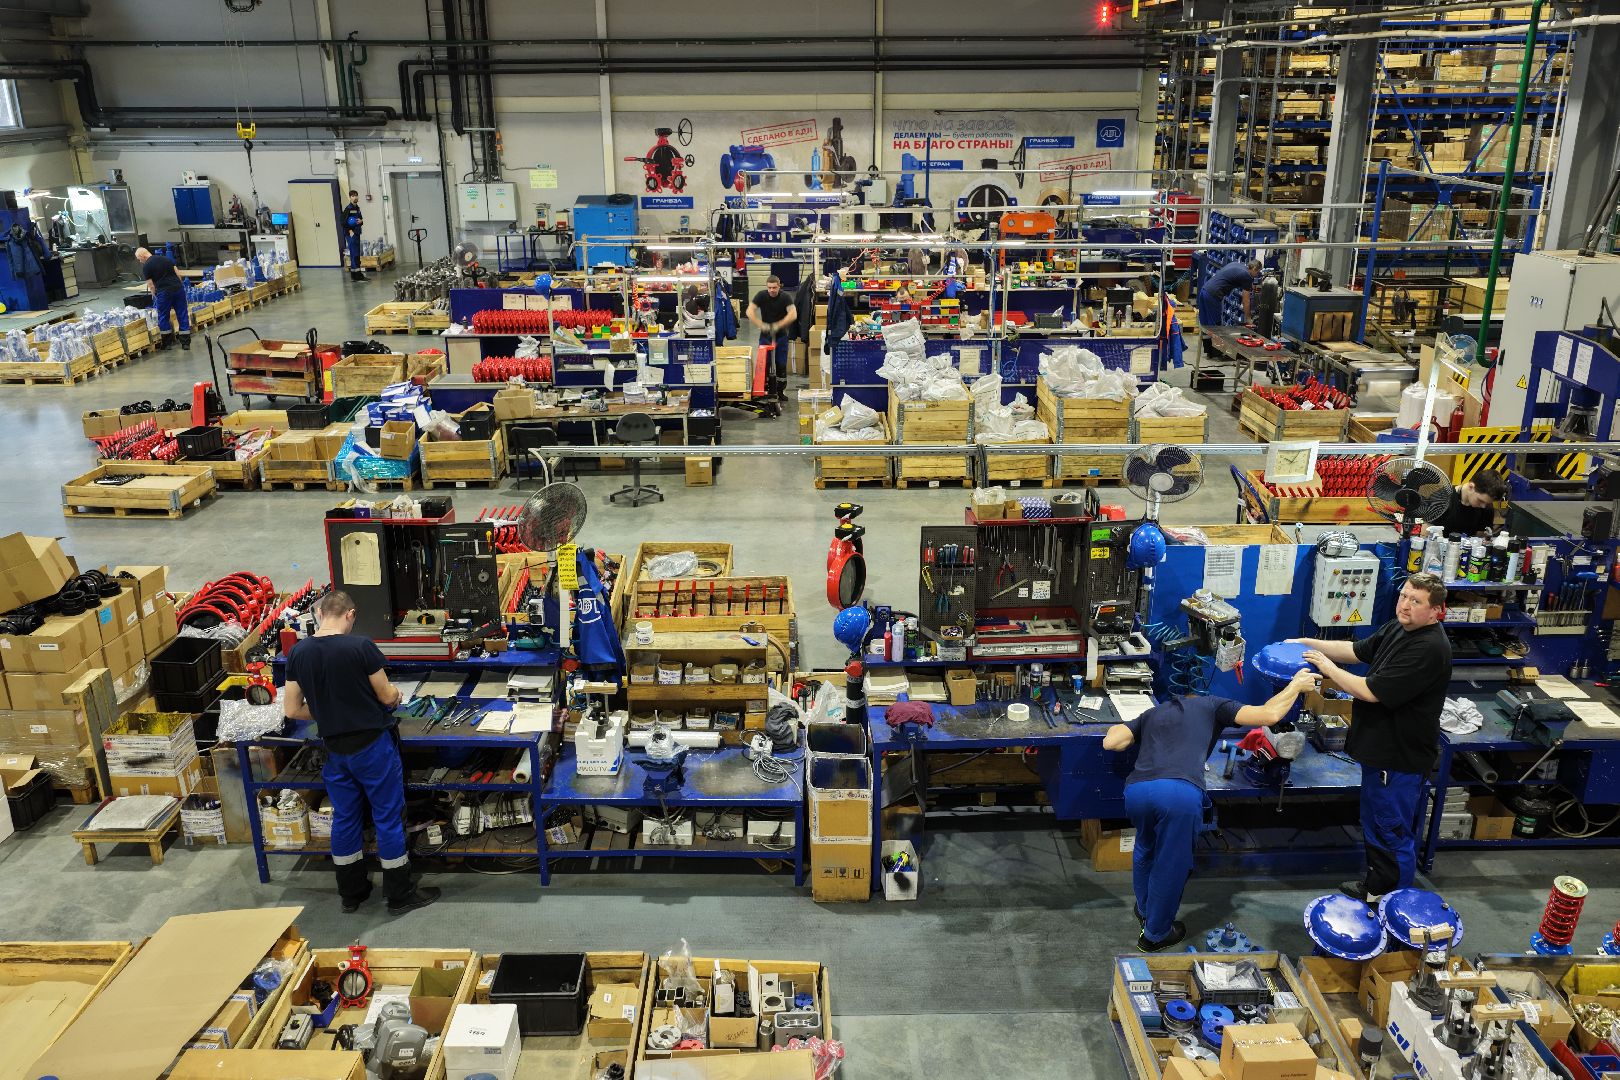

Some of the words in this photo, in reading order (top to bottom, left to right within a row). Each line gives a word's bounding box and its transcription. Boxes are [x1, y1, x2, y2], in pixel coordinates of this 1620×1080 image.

[747, 131, 786, 144] СДЕЛАНО
[893, 132, 926, 140] ДЕЛАЕМ
[893, 140, 911, 150] НА
[957, 140, 1013, 150] СТРАНЫ!
